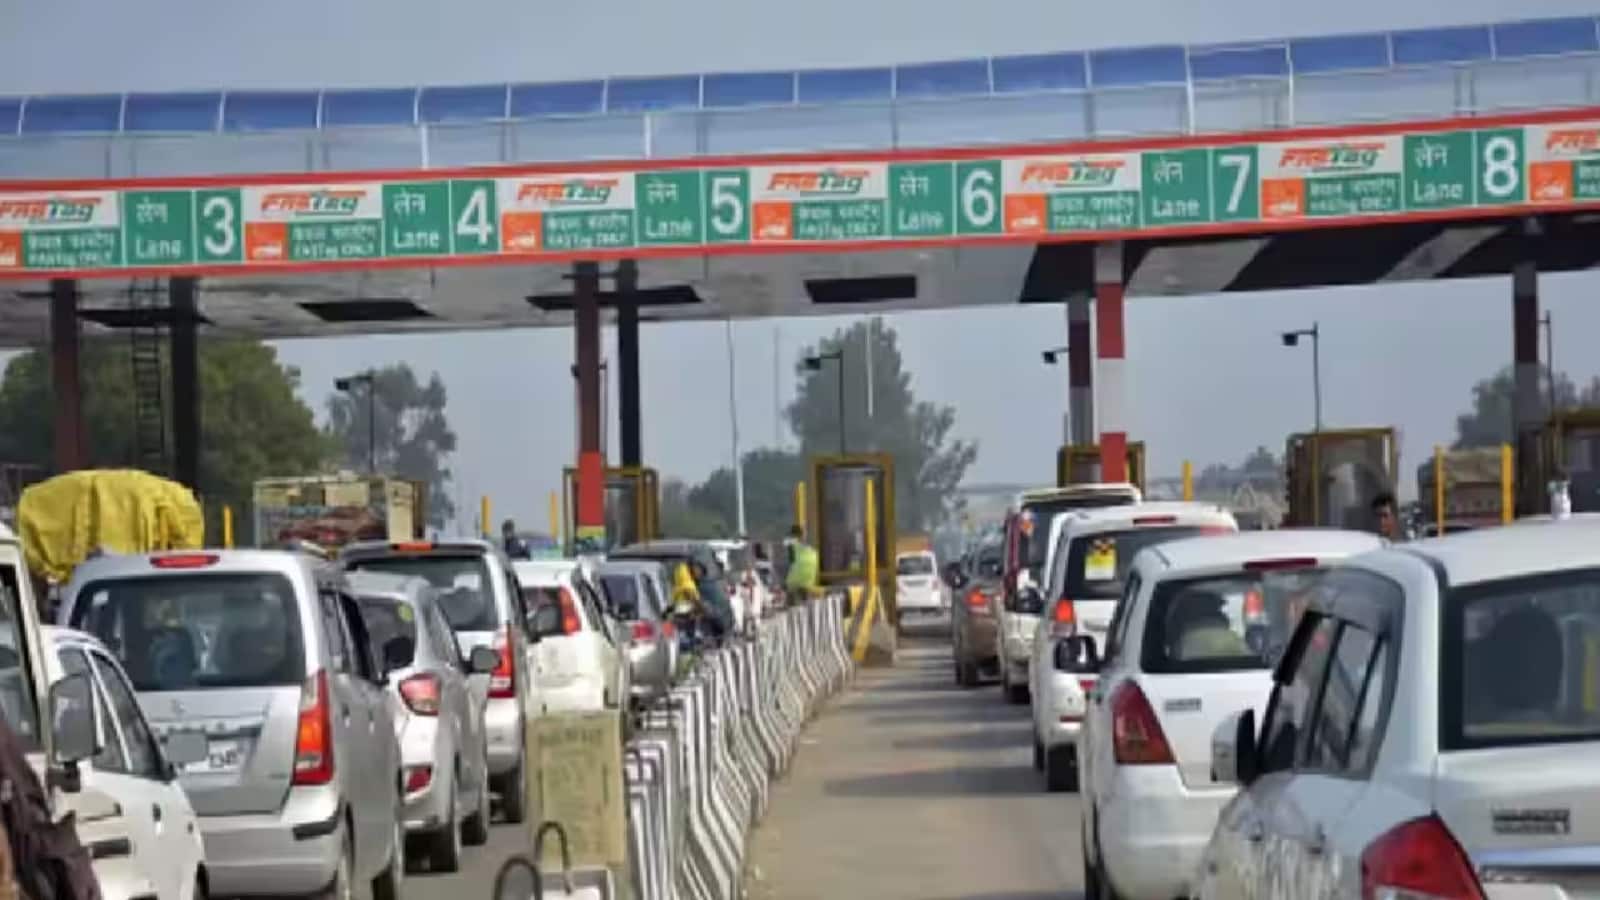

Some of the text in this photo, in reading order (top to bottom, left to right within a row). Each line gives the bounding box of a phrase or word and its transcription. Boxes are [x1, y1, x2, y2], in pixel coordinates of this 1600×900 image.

[1415, 139, 1447, 168] लेन
[1483, 136, 1518, 197] 8
[1153, 156, 1183, 183] लेन
[1219, 154, 1251, 212] 7
[647, 180, 678, 203] लेन
[899, 170, 928, 197] लेन
[1414, 180, 1463, 200] Lane
[136, 196, 168, 223] लेन
[393, 188, 426, 216] लेन
[711, 177, 744, 234] 5
[963, 170, 997, 226] 6
[1153, 197, 1200, 217] Lane
[203, 197, 235, 255] 3
[457, 188, 492, 245] 4
[646, 218, 693, 238] Lane
[899, 209, 944, 230] Lane
[136, 240, 182, 258] Lane
[393, 228, 440, 248] Lane
